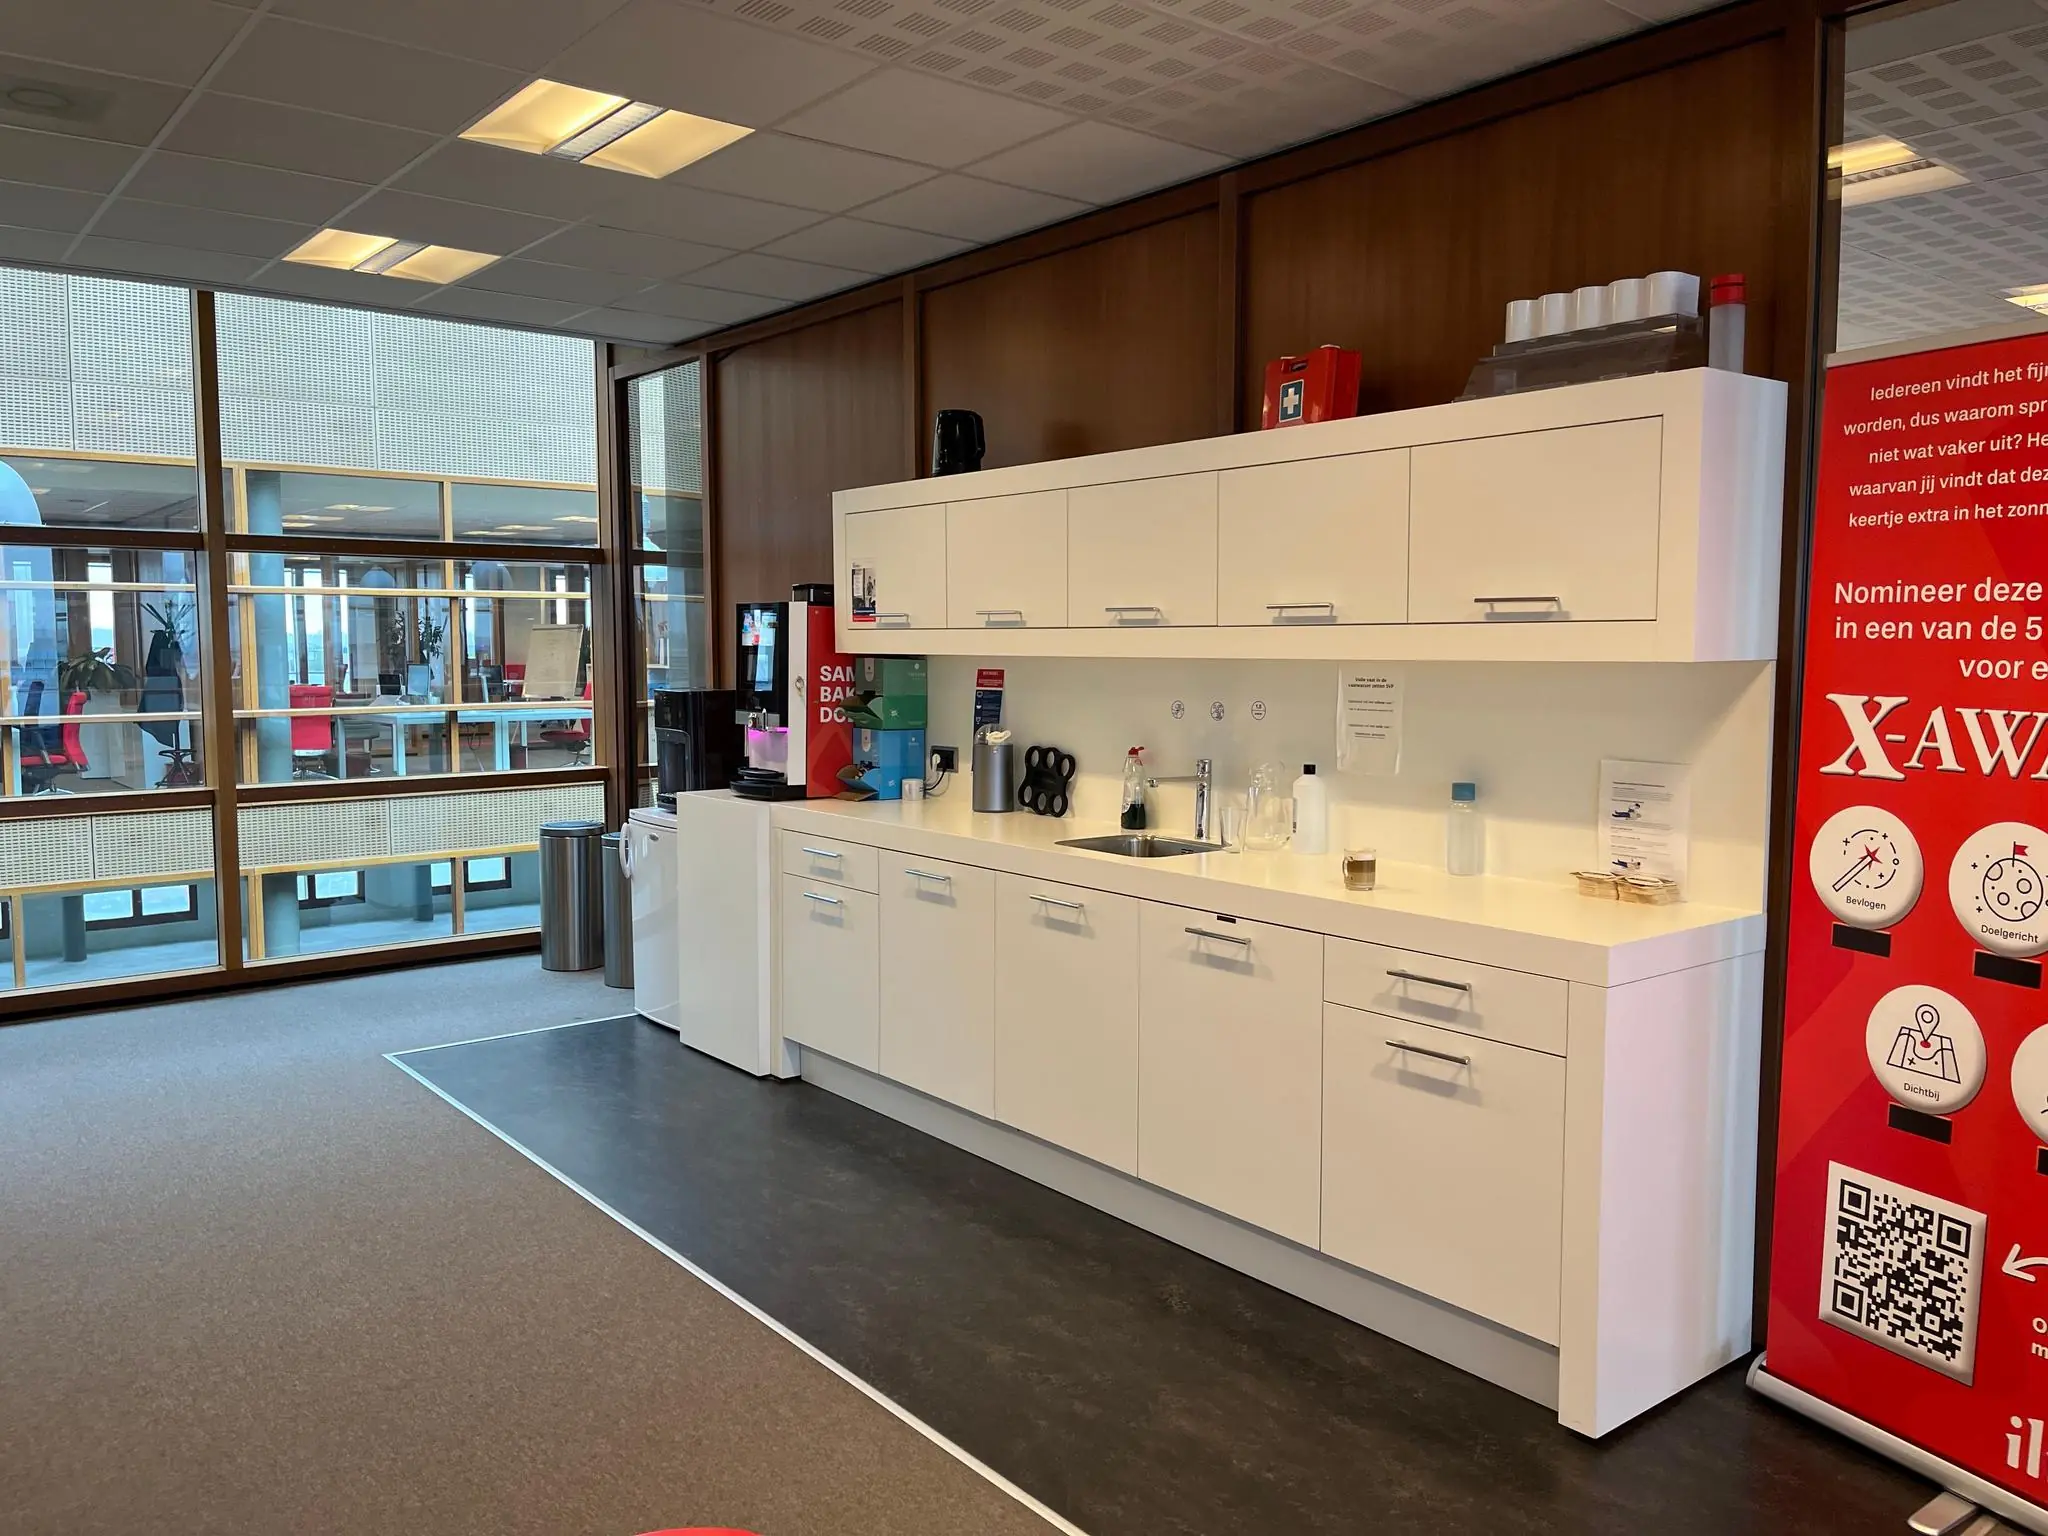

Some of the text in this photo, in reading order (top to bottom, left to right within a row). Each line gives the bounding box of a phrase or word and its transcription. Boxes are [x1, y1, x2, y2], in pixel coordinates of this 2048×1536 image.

[1871, 381, 1940, 400] Iedereen
[1946, 371, 1989, 389] vindt
[1994, 367, 2022, 383] het
[1844, 400, 2047, 435] worden, dus waarom spr
[1870, 432, 2048, 463] niet wat vaker uit? He
[1850, 480, 1916, 496] waarvan
[1920, 475, 1935, 494] jij
[1940, 471, 1983, 488] vindt
[1987, 469, 2016, 485] dat
[1849, 511, 1903, 528] keertje
[1908, 509, 1949, 523] extra
[1954, 506, 1969, 520] in
[1975, 504, 2003, 519] het
[1835, 577, 2042, 603] Nomineer deze
[1836, 615, 2042, 640] in een van de 5
[1959, 660, 2024, 678] voor
[820, 707, 854, 723] DO
[1846, 895, 1887, 911] Bevlogen
[1981, 924, 2039, 944] Doelgericht
[1903, 1082, 1940, 1102] Dichtbij
